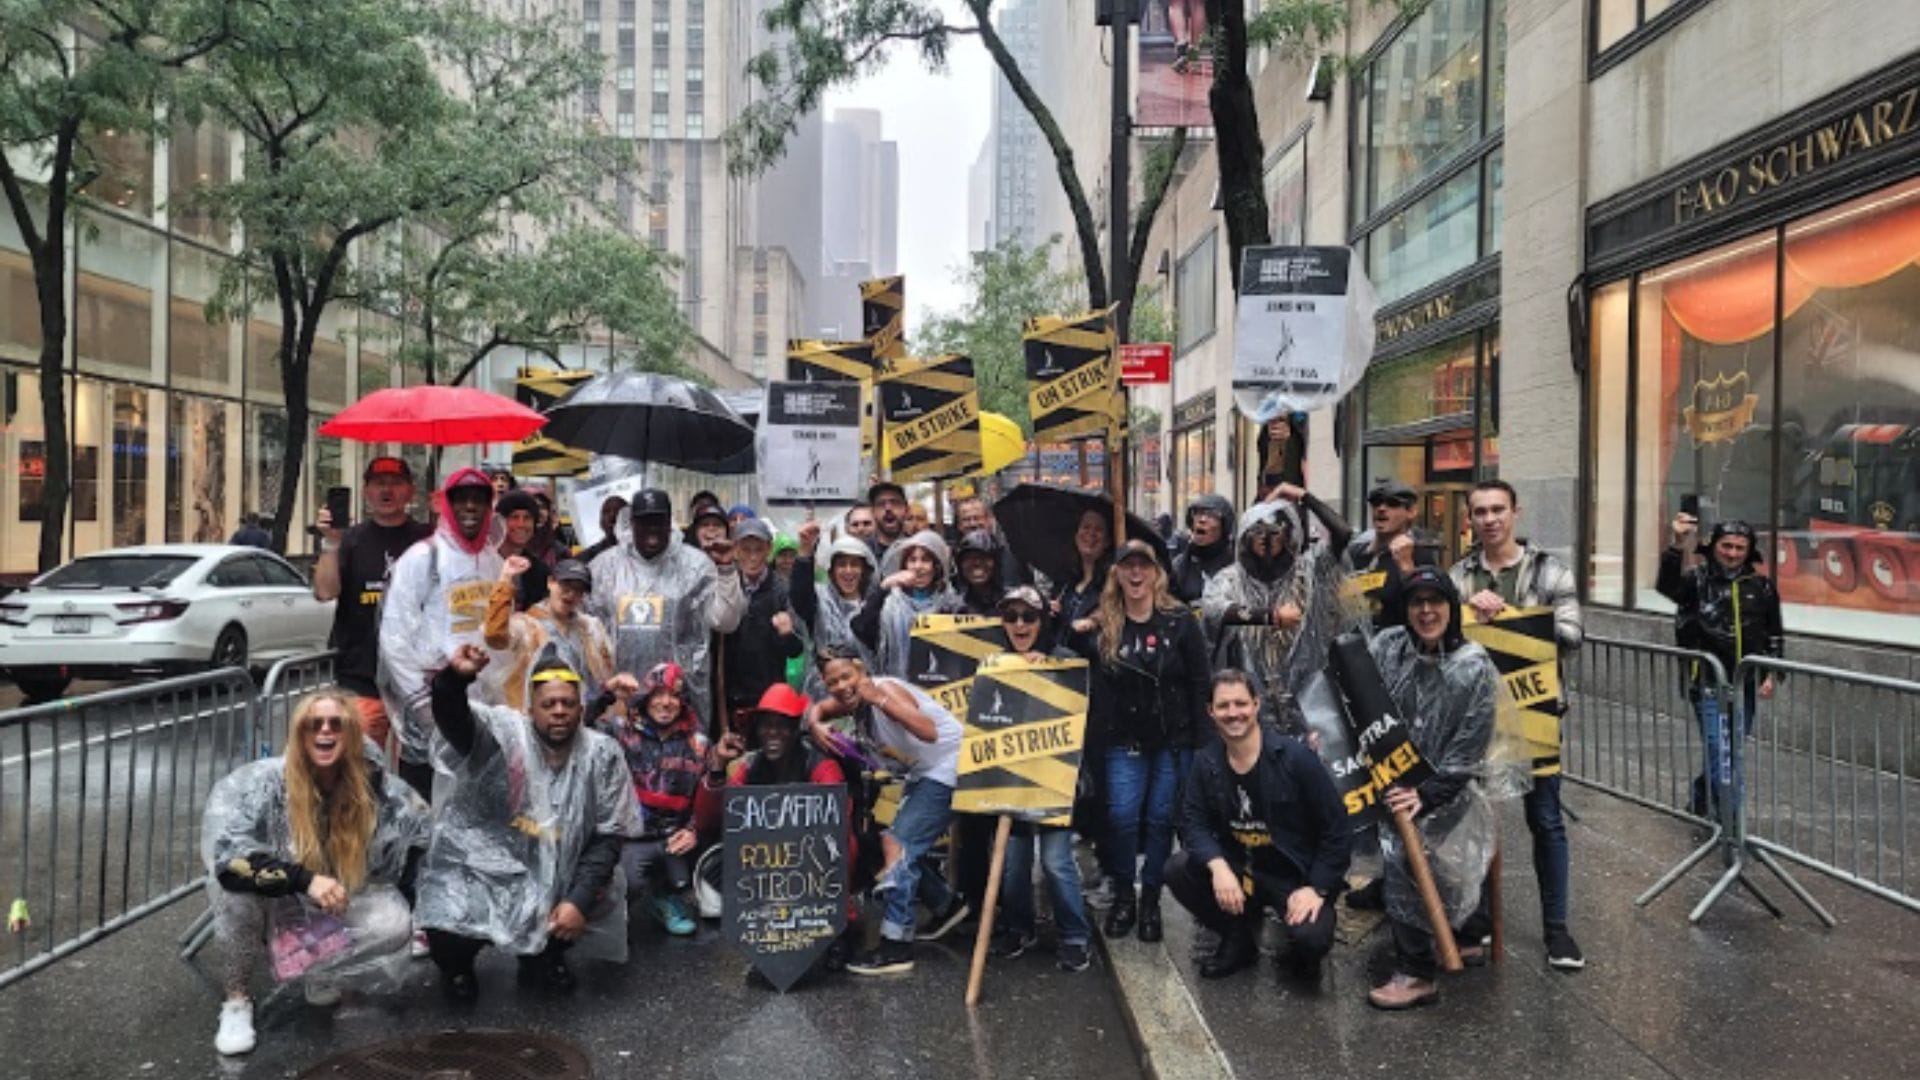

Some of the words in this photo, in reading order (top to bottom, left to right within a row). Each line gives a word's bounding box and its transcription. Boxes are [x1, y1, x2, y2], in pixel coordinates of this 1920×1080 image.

[1748, 88, 1919, 195] SCHWARZ
[1037, 385, 1060, 408] ON
[894, 427, 918, 449] ON
[918, 400, 971, 439] STRIKE
[971, 737, 996, 764] ON
[1002, 721, 1074, 756] STRIKE
[1343, 741, 1420, 816] STIKE!
[726, 793, 840, 832] SAGAFTRA
[739, 833, 825, 873] POWER
[737, 868, 843, 901] STRONG
